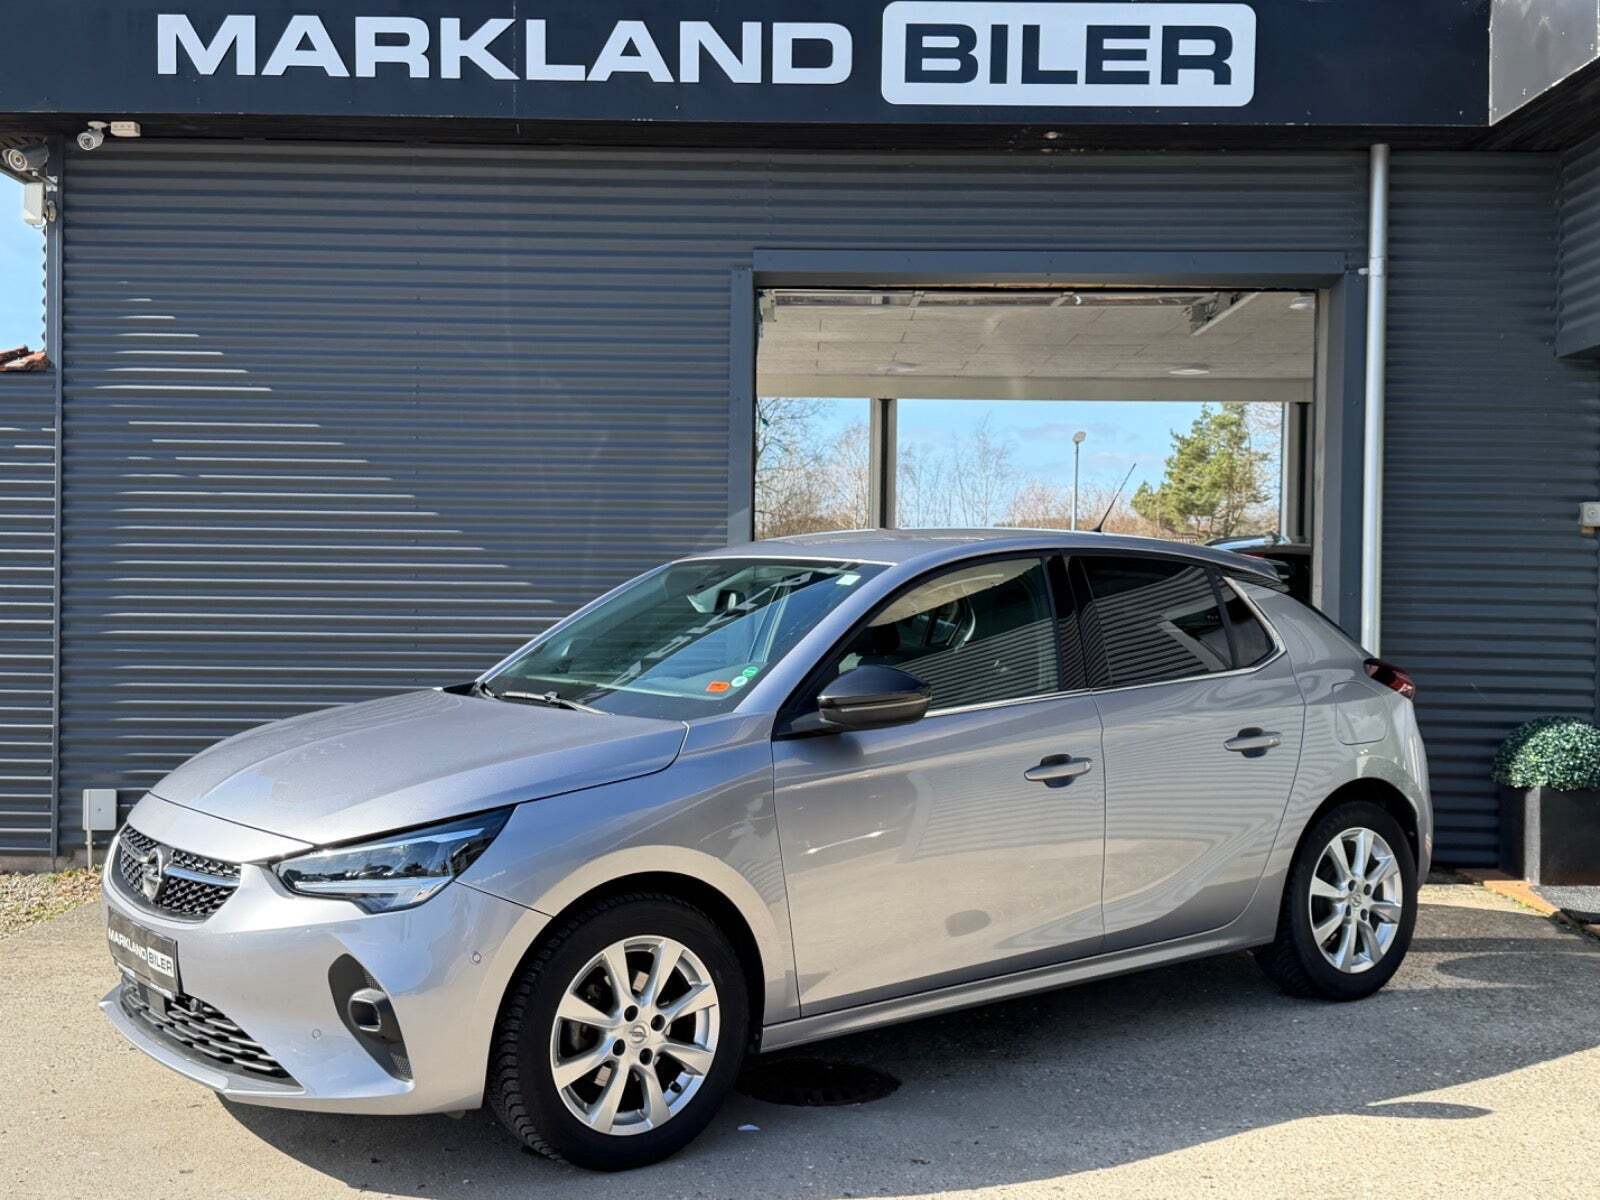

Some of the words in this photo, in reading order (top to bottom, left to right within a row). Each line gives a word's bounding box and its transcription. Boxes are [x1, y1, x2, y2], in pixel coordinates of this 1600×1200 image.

[157, 14, 853, 85] MARKLAND
[904, 23, 1233, 86] BILER
[108, 928, 148, 961] MARKLAND
[148, 950, 173, 973] BILER
